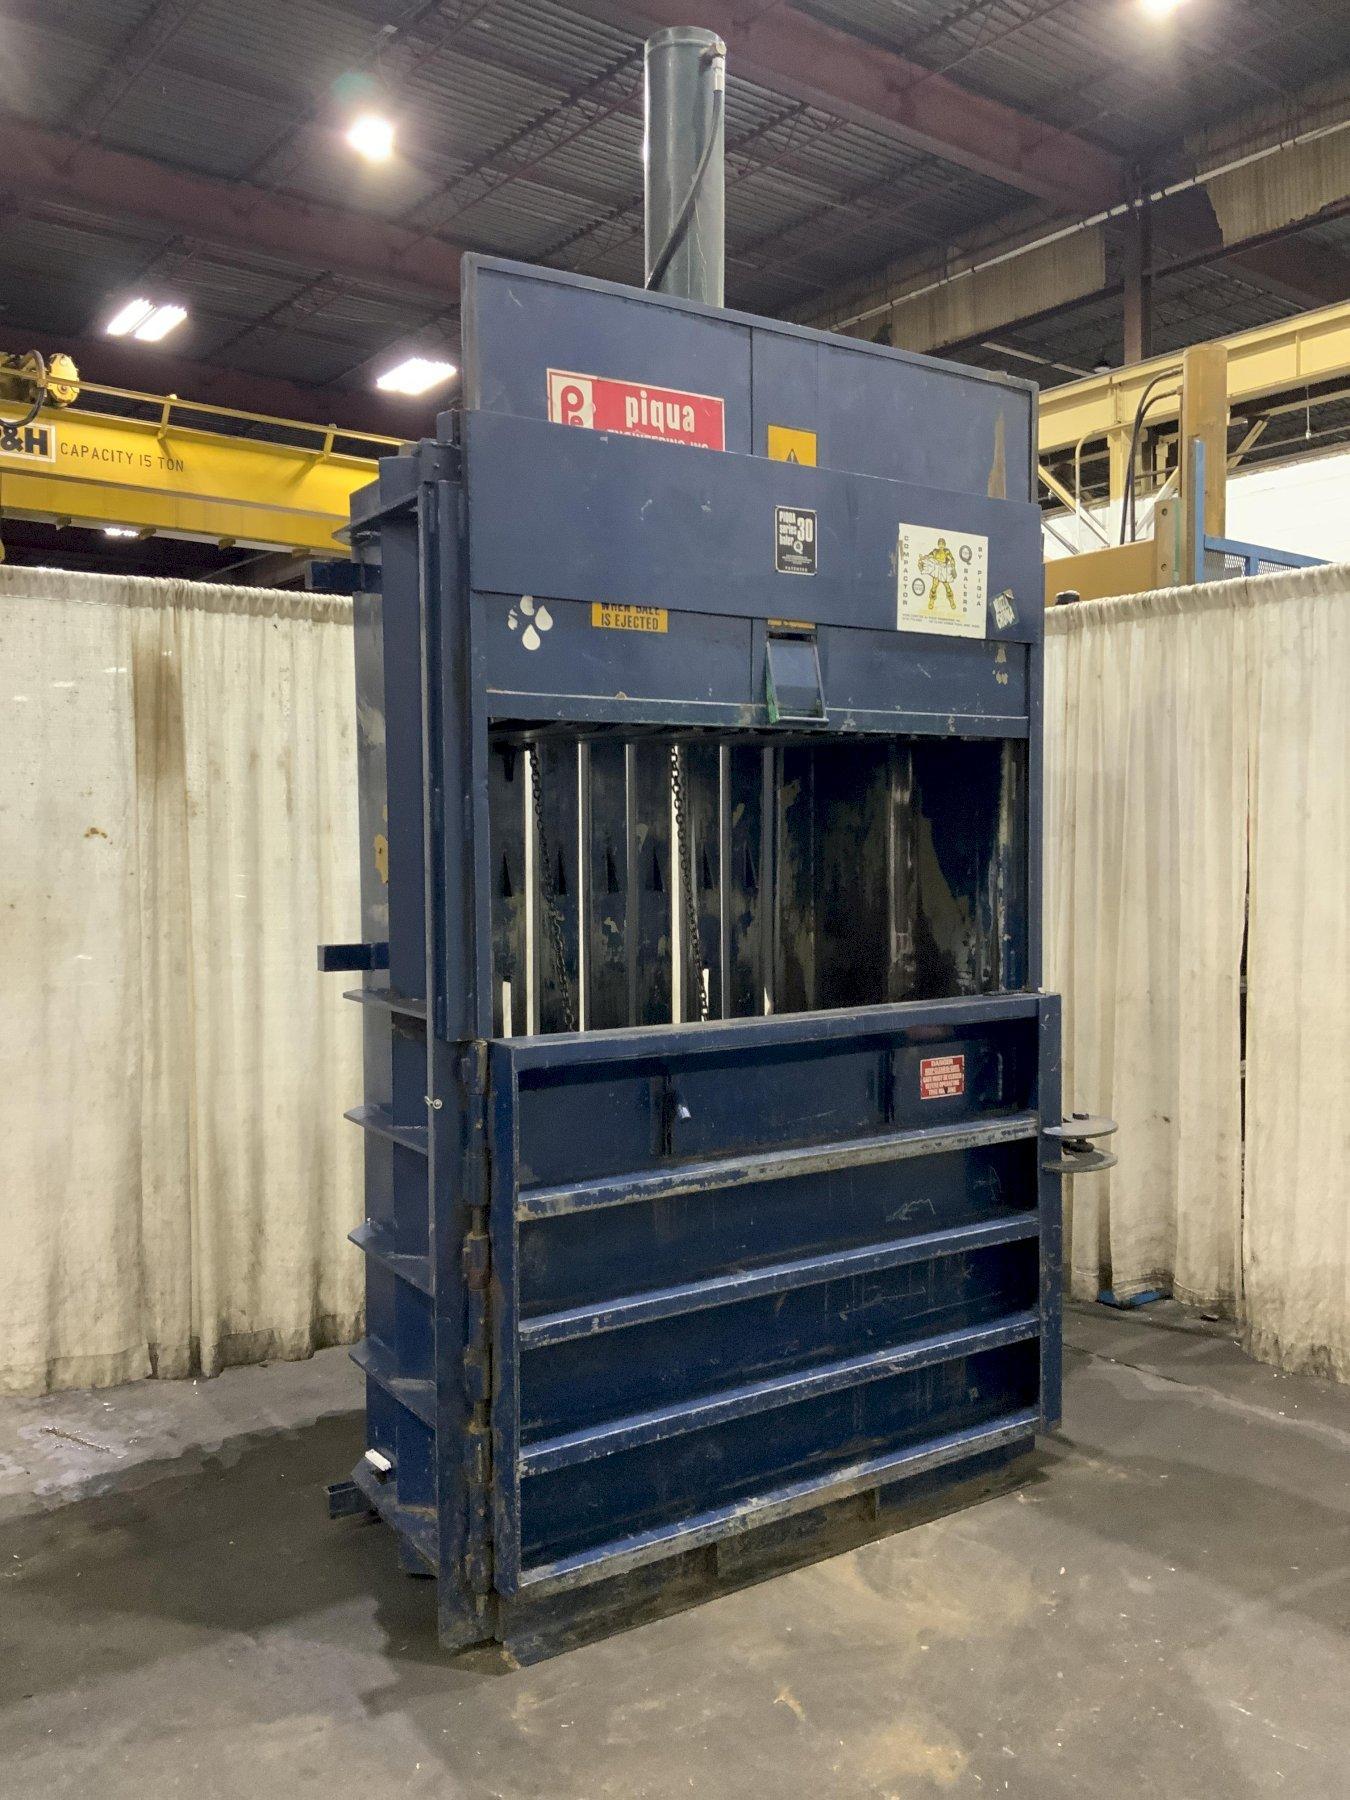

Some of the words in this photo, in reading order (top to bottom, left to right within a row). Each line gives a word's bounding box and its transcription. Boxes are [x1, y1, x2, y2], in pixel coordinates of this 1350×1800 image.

[625, 390, 695, 433] piqua
[60, 442, 133, 465] CAPACITY
[139, 455, 152, 468] 15
[158, 457, 184, 472] TON
[797, 517, 813, 542] 30
[601, 613, 611, 626] IS
[615, 614, 659, 630] EJECTED
